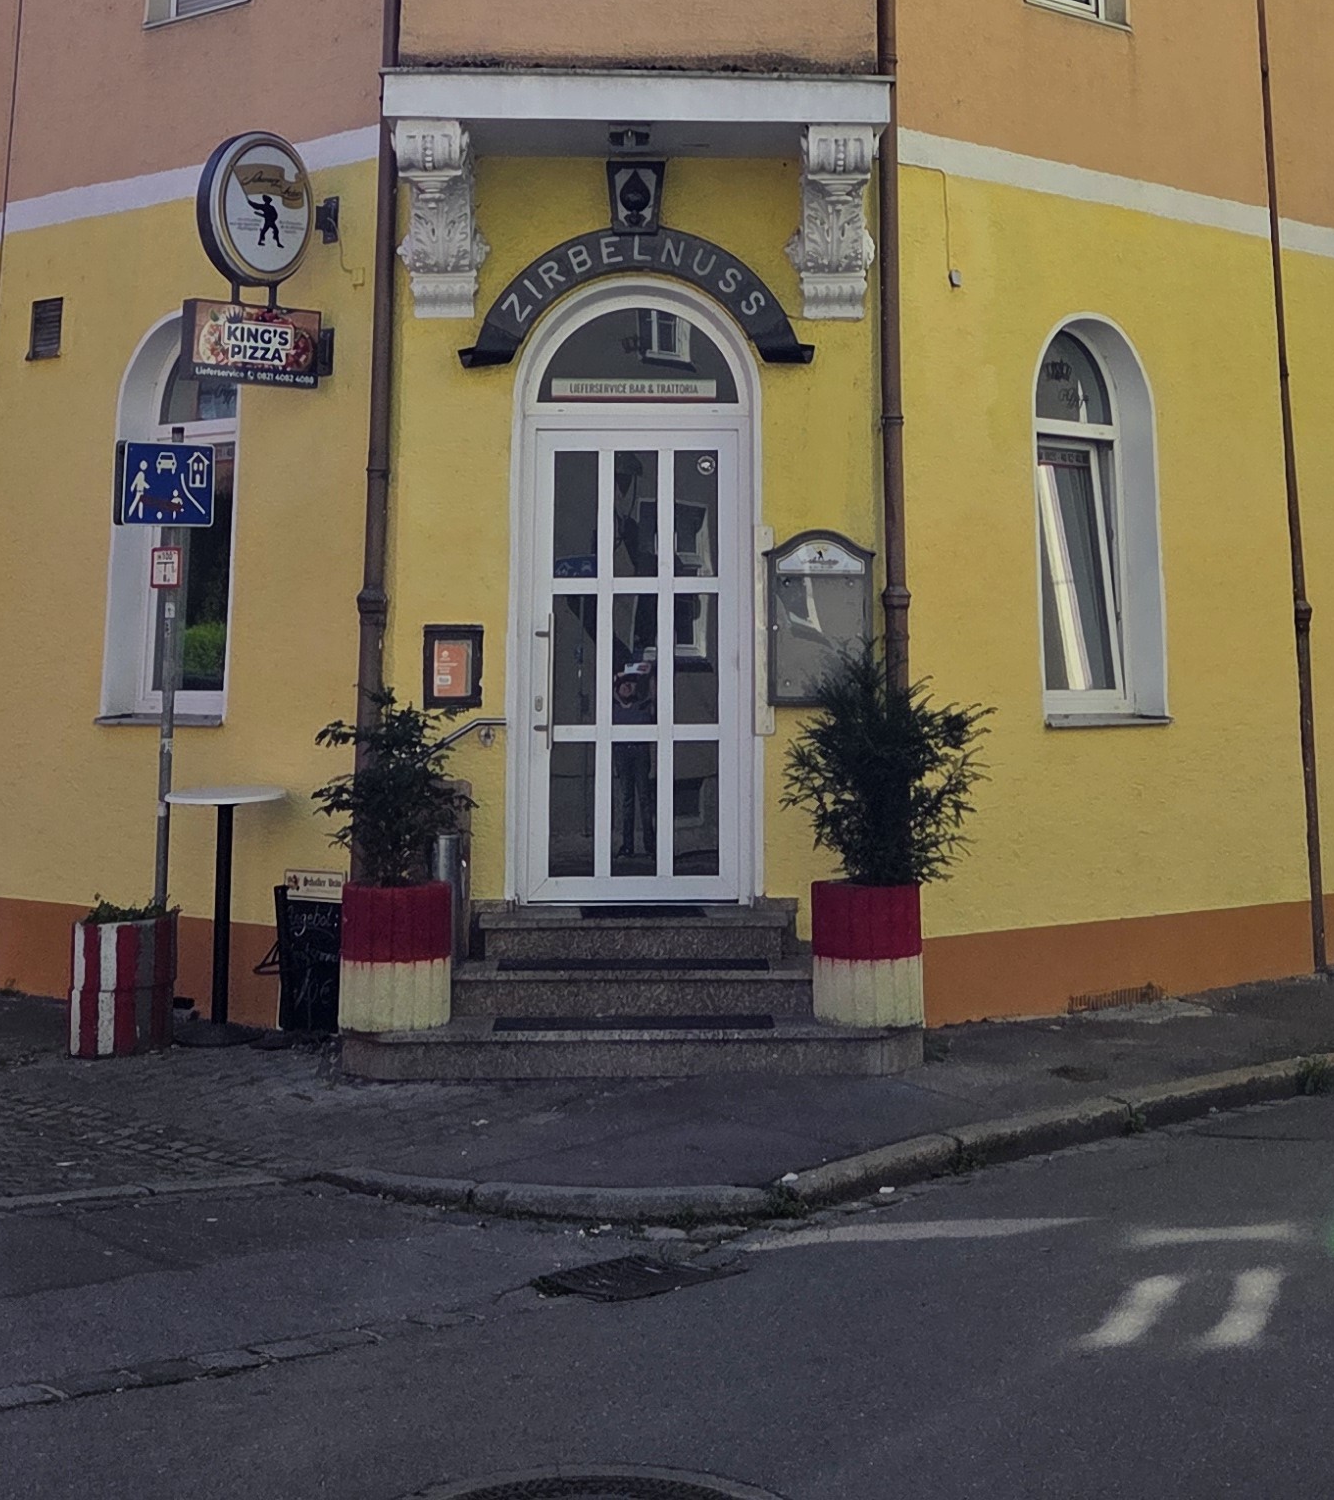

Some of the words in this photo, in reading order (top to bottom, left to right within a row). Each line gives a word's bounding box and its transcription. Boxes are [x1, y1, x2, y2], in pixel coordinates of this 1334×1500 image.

[501, 234, 766, 323] ZIRBELNUSS
[226, 325, 289, 347] KING'S
[230, 343, 284, 363] PIZZA
[195, 366, 245, 379] Lieferservice
[256, 371, 274, 382] 0821
[569, 382, 627, 394] LIEFERSERVICE
[629, 383, 646, 394] BAR
[647, 384, 654, 394] &
[656, 383, 699, 395] TRATTORIA
